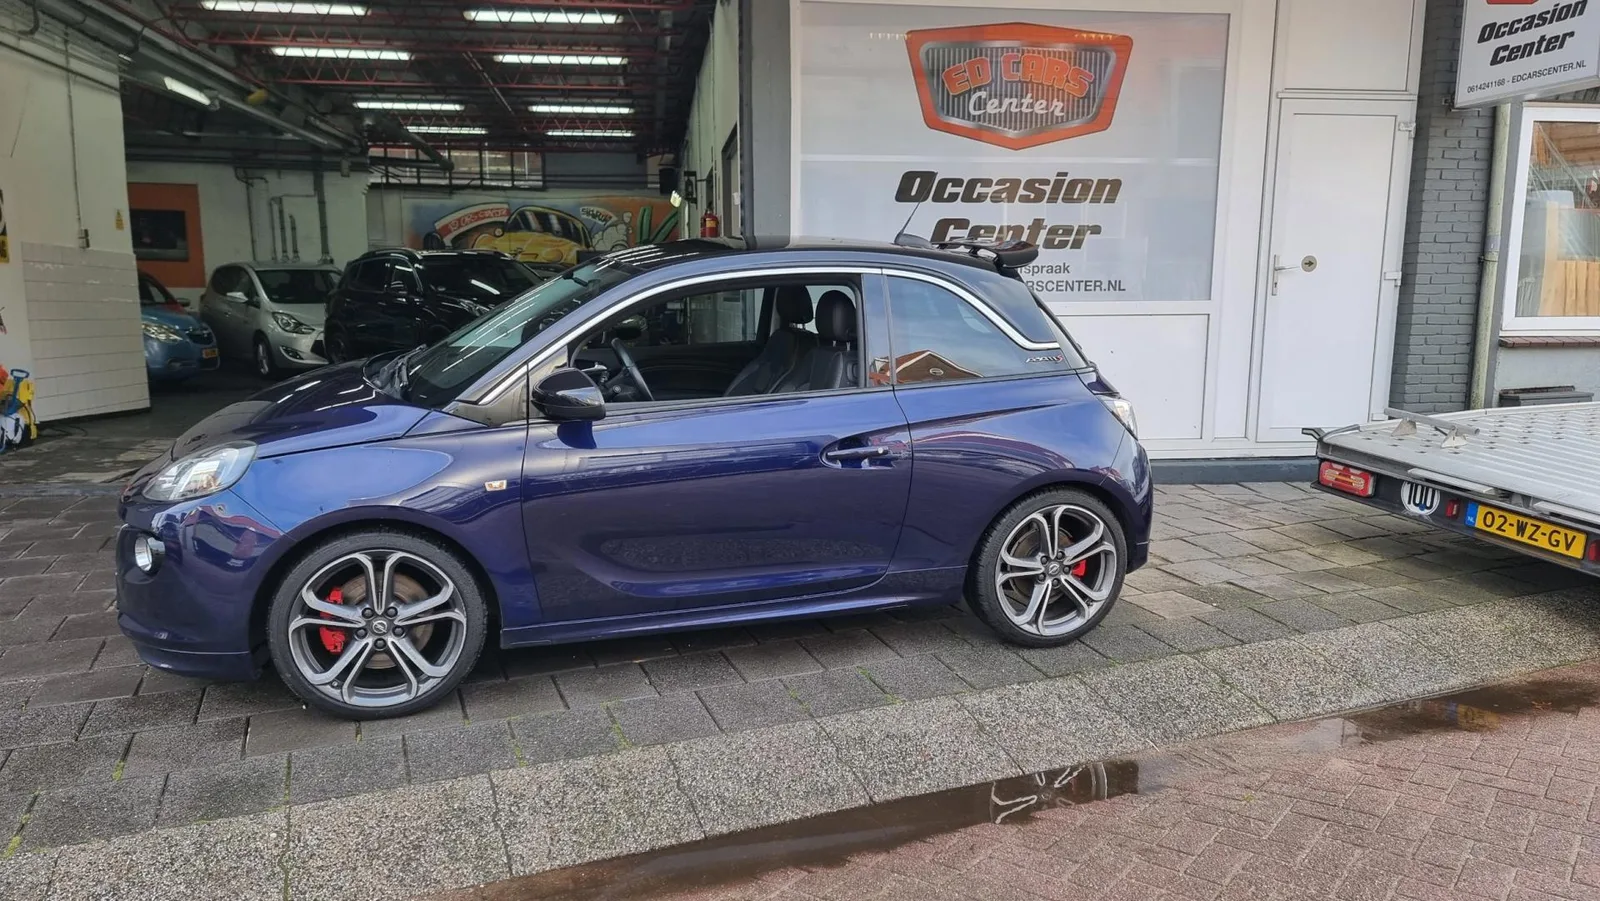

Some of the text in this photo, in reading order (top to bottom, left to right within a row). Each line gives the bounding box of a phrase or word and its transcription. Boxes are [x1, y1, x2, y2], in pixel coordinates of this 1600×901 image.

[1477, 0, 1588, 44] Occasion
[1489, 31, 1575, 66] Center
[942, 53, 1094, 97] ED CARS
[1511, 60, 1587, 84] EDCARSCENTER.NL
[968, 91, 1065, 116] Center
[895, 171, 1122, 203] Occasion
[1019, 262, 1070, 276] spraak
[1026, 280, 1126, 292] RSCENTER.NL
[1482, 511, 1576, 551] 02-WZ-GV
